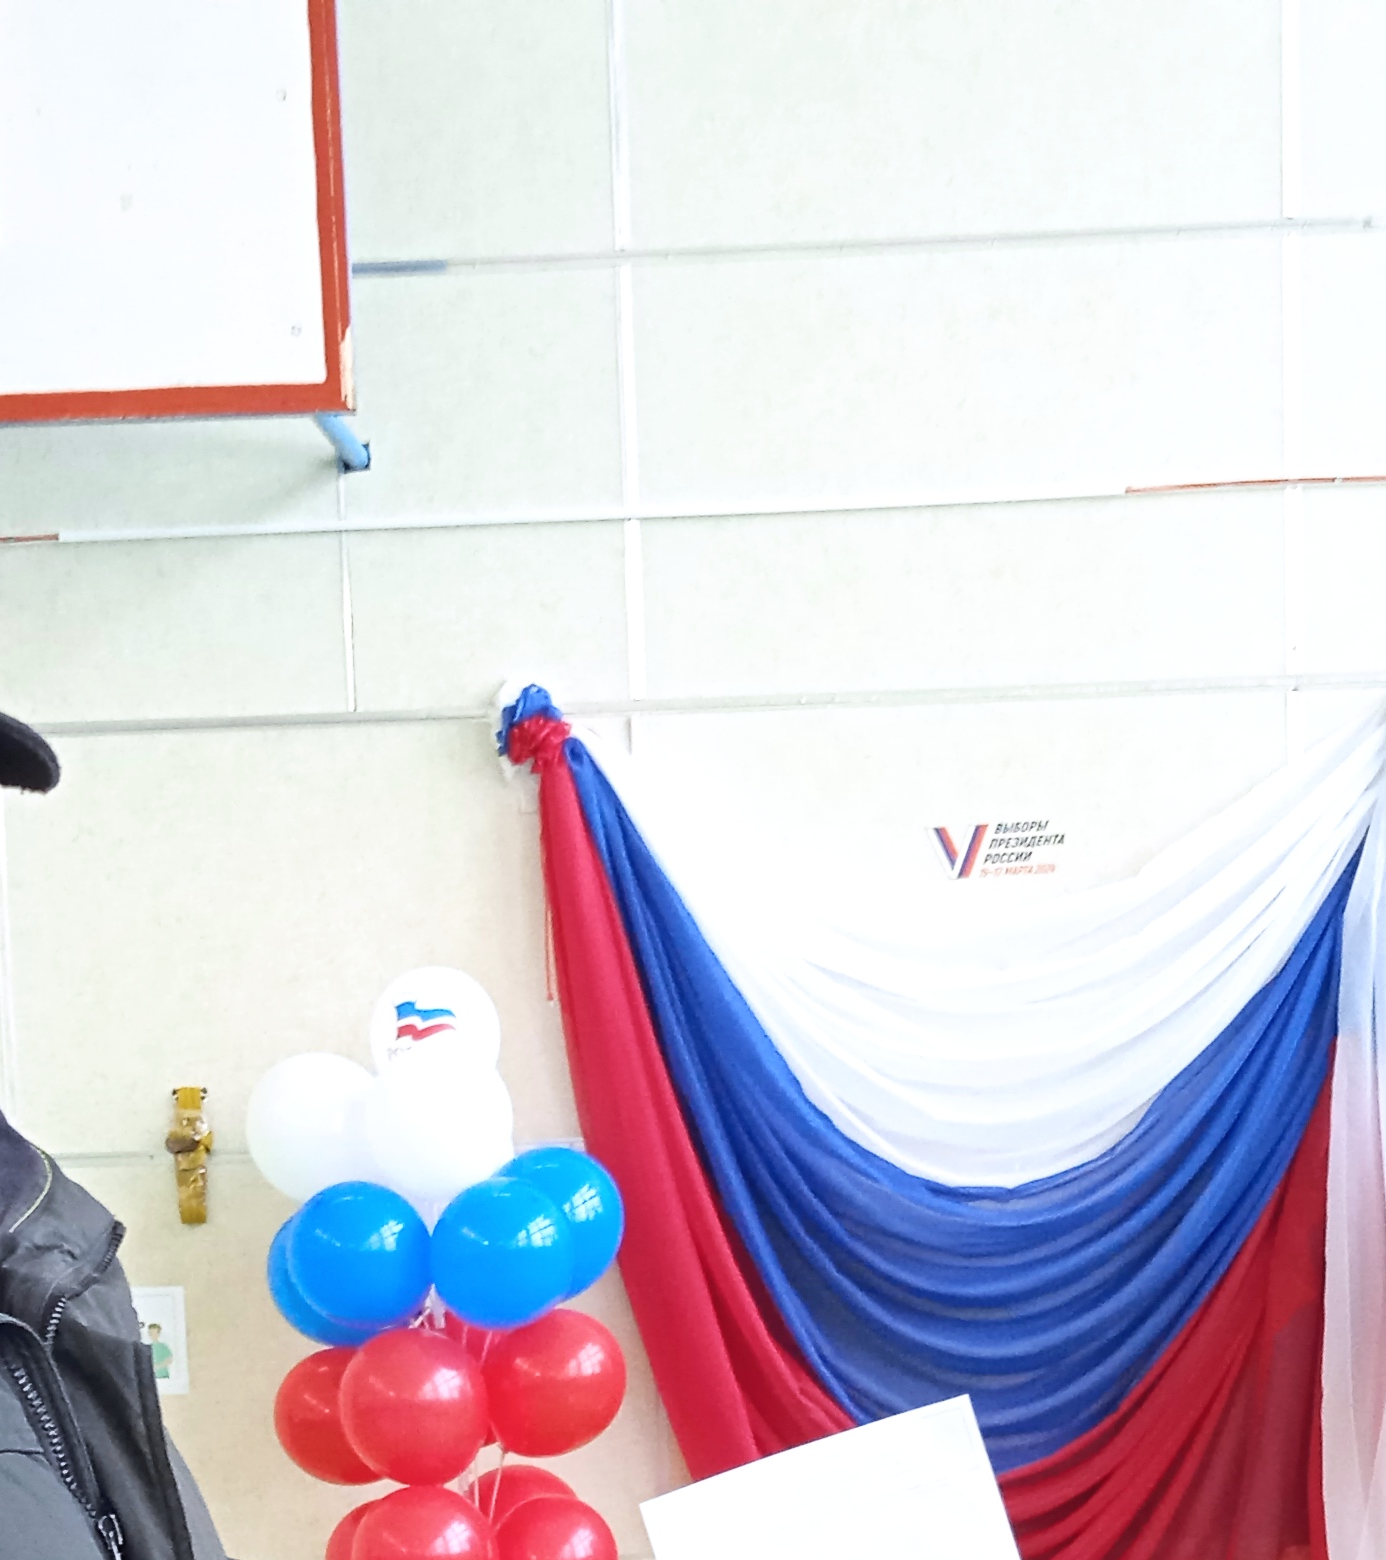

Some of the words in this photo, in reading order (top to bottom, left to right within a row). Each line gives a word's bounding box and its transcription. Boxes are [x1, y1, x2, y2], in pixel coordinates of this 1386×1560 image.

[994, 819, 1050, 834] ВЫБОРЫ
[988, 833, 1066, 850] ПРЕЗИДЕНТА
[983, 851, 1034, 865] РОССИИ
